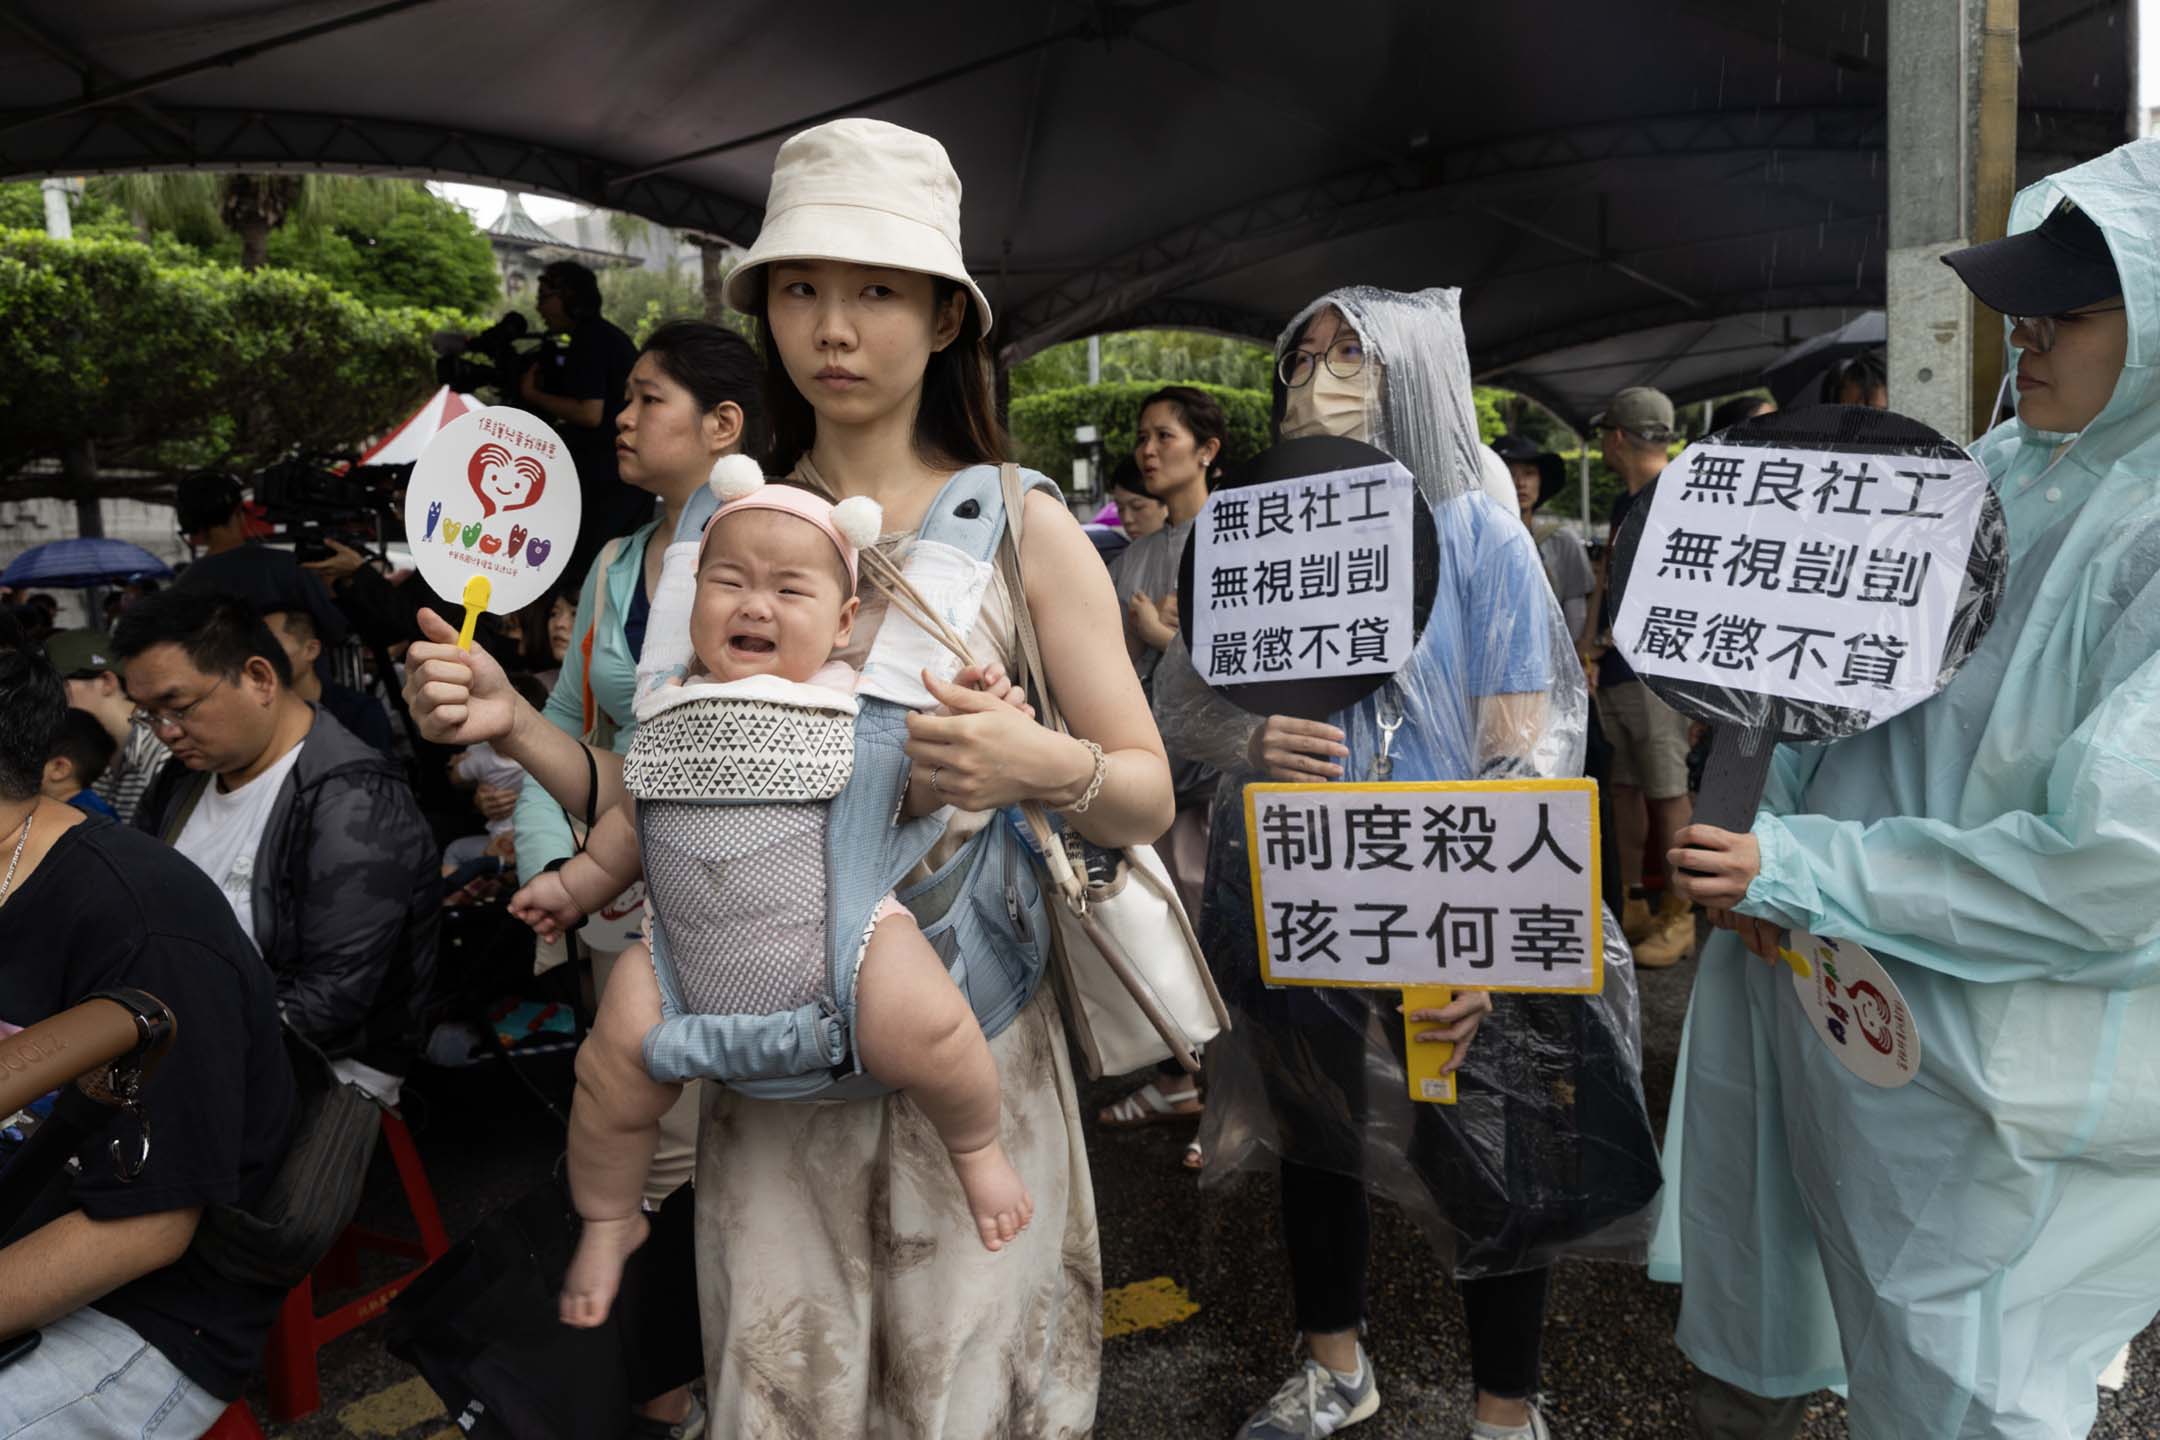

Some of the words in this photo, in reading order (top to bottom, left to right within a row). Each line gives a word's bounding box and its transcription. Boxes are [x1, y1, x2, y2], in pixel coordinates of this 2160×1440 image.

[1212, 479, 1390, 545] 無良社工
[1680, 452, 1951, 519] 無良社工
[1210, 544, 1389, 611] 無視剴剴
[1657, 527, 1931, 608] 無視剴剴
[1209, 616, 1389, 678] 嚴懲不貸
[1633, 605, 1909, 691] 嚴懲不貸
[1262, 803, 1584, 875] 制度殺人
[1271, 900, 1585, 972] 孩子何辜
